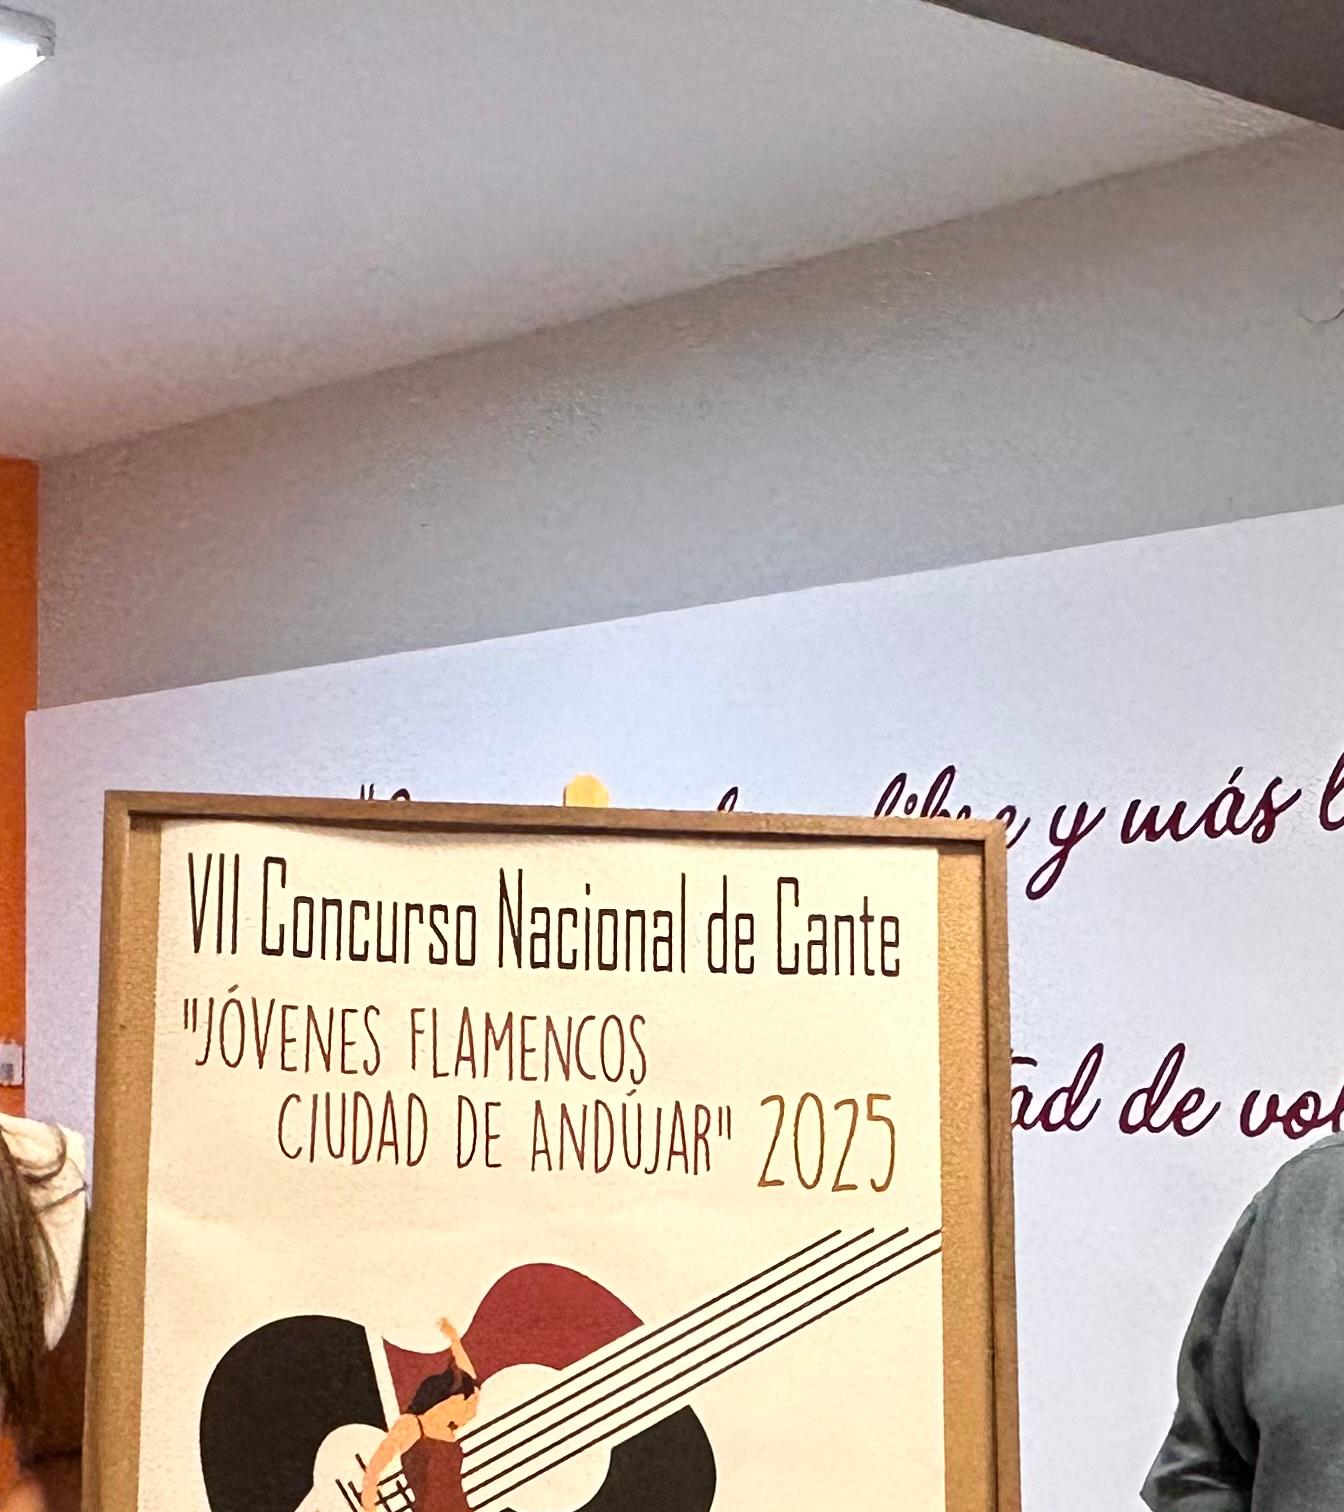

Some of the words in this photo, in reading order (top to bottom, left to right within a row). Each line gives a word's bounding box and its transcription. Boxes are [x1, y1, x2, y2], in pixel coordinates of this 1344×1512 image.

[1026, 801, 1107, 901] y
[1120, 766, 1303, 845] más
[188, 852, 239, 955] VII
[261, 856, 477, 966] Concurso
[498, 867, 686, 973] Nacional
[707, 874, 754, 975] de
[777, 876, 901, 978] Cante
[183, 984, 381, 1077] "JÓVENES
[411, 1005, 646, 1085] FLAMENCOS
[278, 1090, 428, 1168] CIUDAD
[457, 1095, 503, 1170] DE
[532, 1089, 731, 1176] ANDÚJAR"
[757, 1092, 896, 1193] 2025
[1119, 1043, 1221, 1138] de
